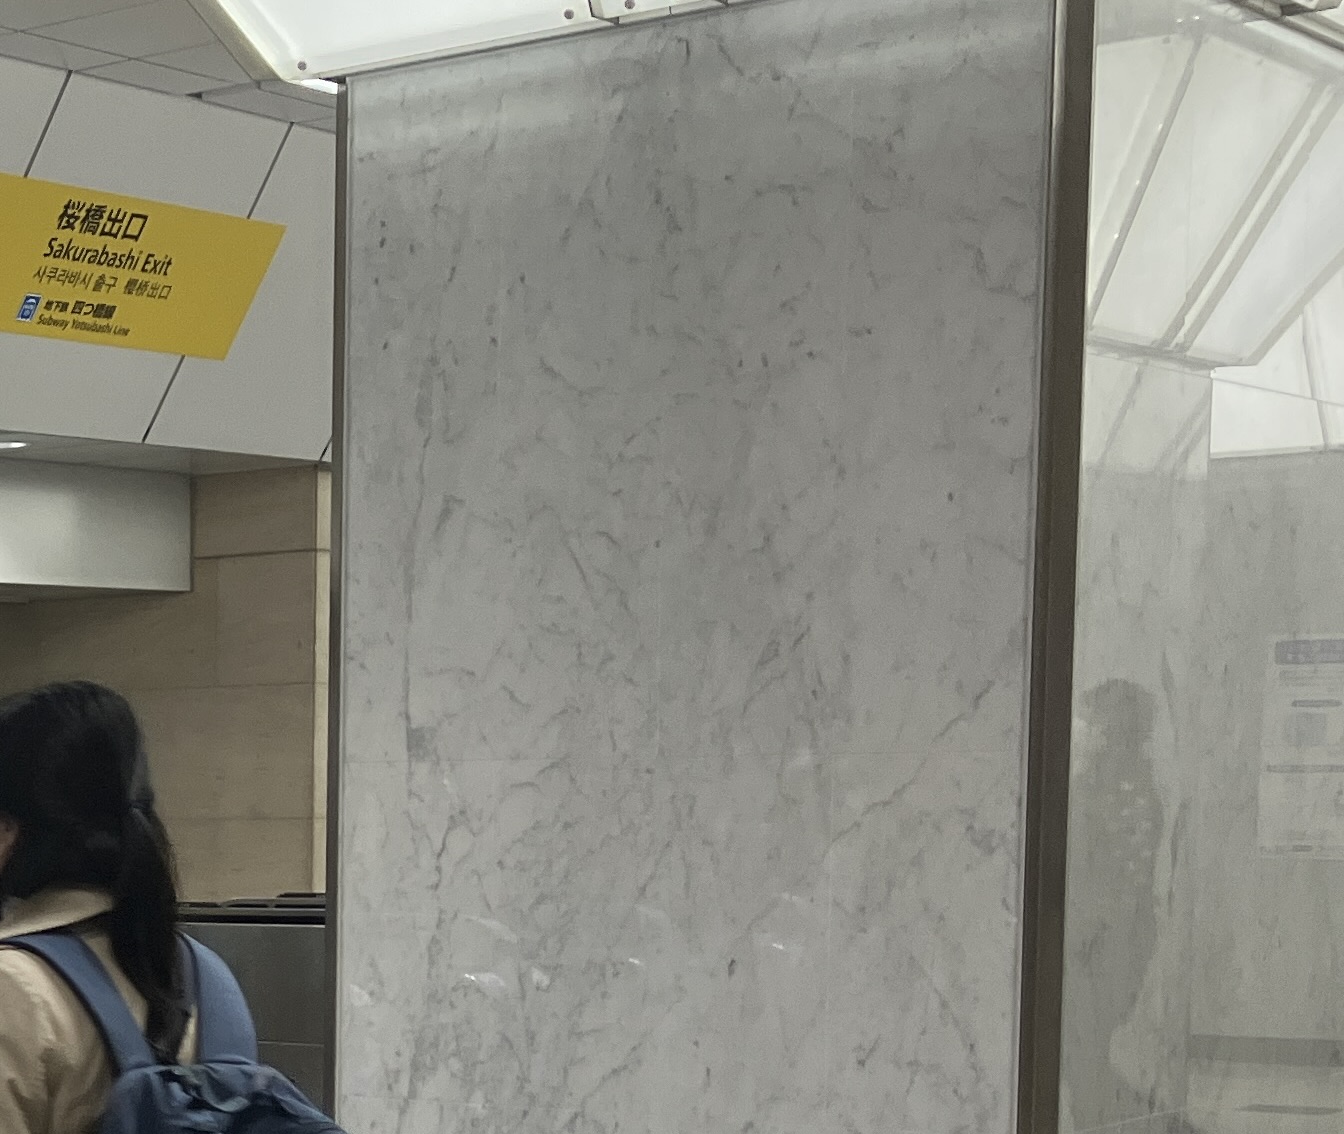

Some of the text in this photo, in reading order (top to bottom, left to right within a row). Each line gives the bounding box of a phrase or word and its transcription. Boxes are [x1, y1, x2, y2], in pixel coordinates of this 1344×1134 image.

[56, 198, 149, 243] 桜橋出口
[42, 237, 173, 277] Sakurabashi Exit
[32, 265, 119, 294] 사쿠라바시 출구
[36, 313, 71, 331] Subway
